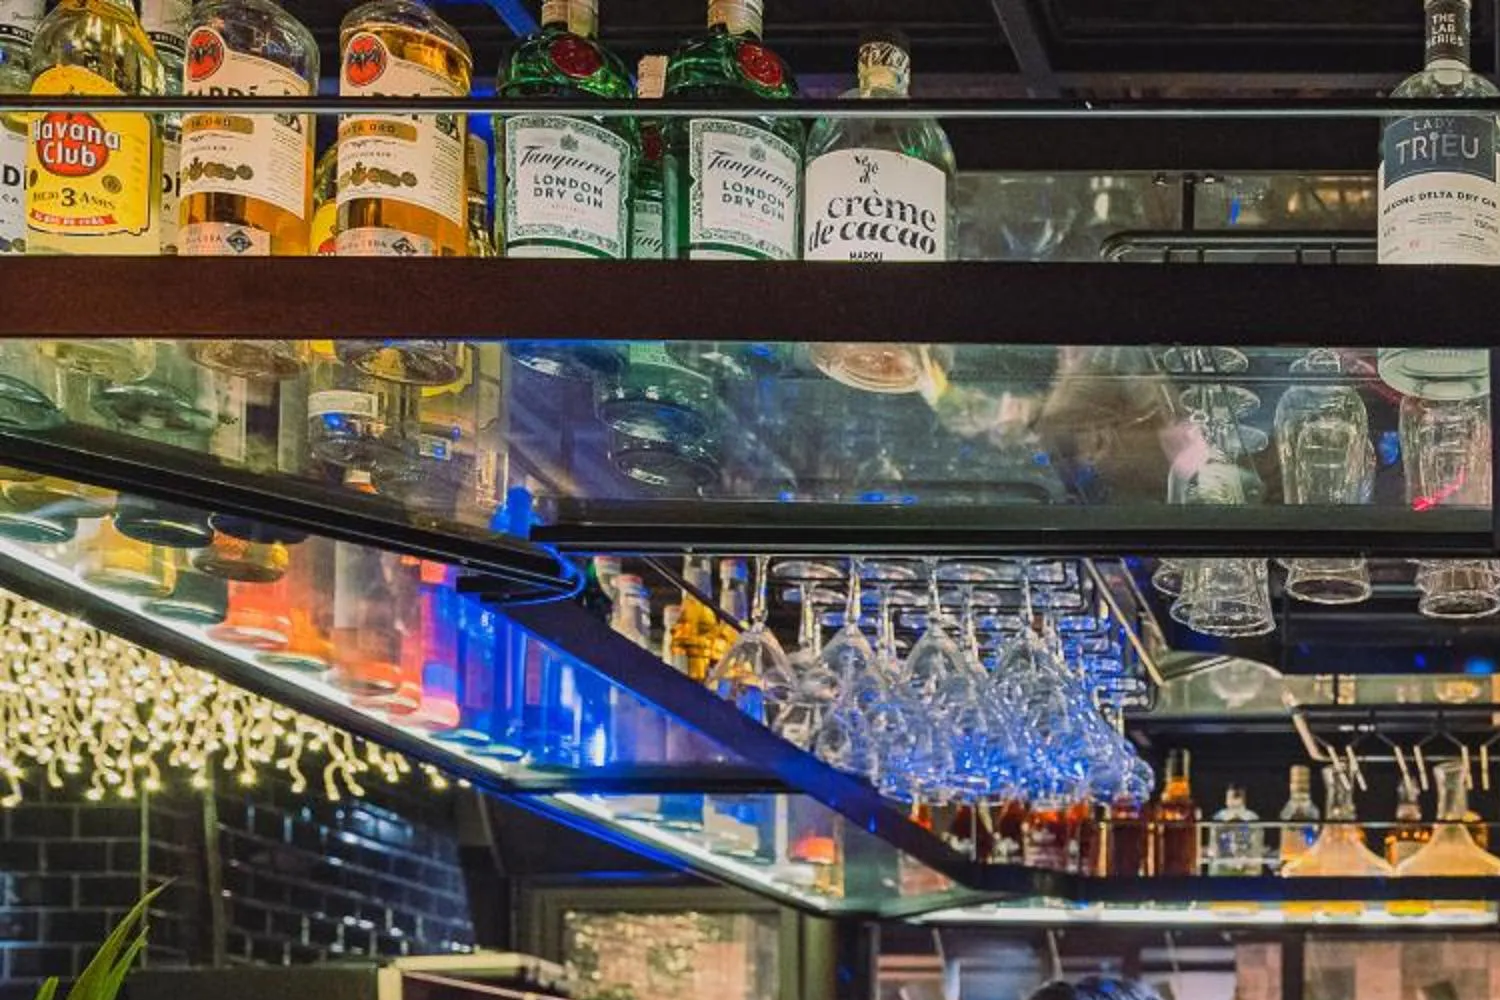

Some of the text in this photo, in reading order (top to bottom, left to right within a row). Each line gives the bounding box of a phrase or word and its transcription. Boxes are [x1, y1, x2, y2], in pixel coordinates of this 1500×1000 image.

[33, 119, 121, 152] Havana
[43, 141, 97, 168] Club
[519, 145, 617, 185] Tanqueray
[533, 175, 604, 197] LONDON
[707, 149, 795, 198] Tanqueray
[60, 187, 76, 207] 3
[533, 187, 604, 209] DRY GIN
[721, 193, 785, 222] DRY GIN
[722, 180, 785, 209] LONDON
[827, 188, 937, 233] crème
[808, 218, 936, 255] de cacao
